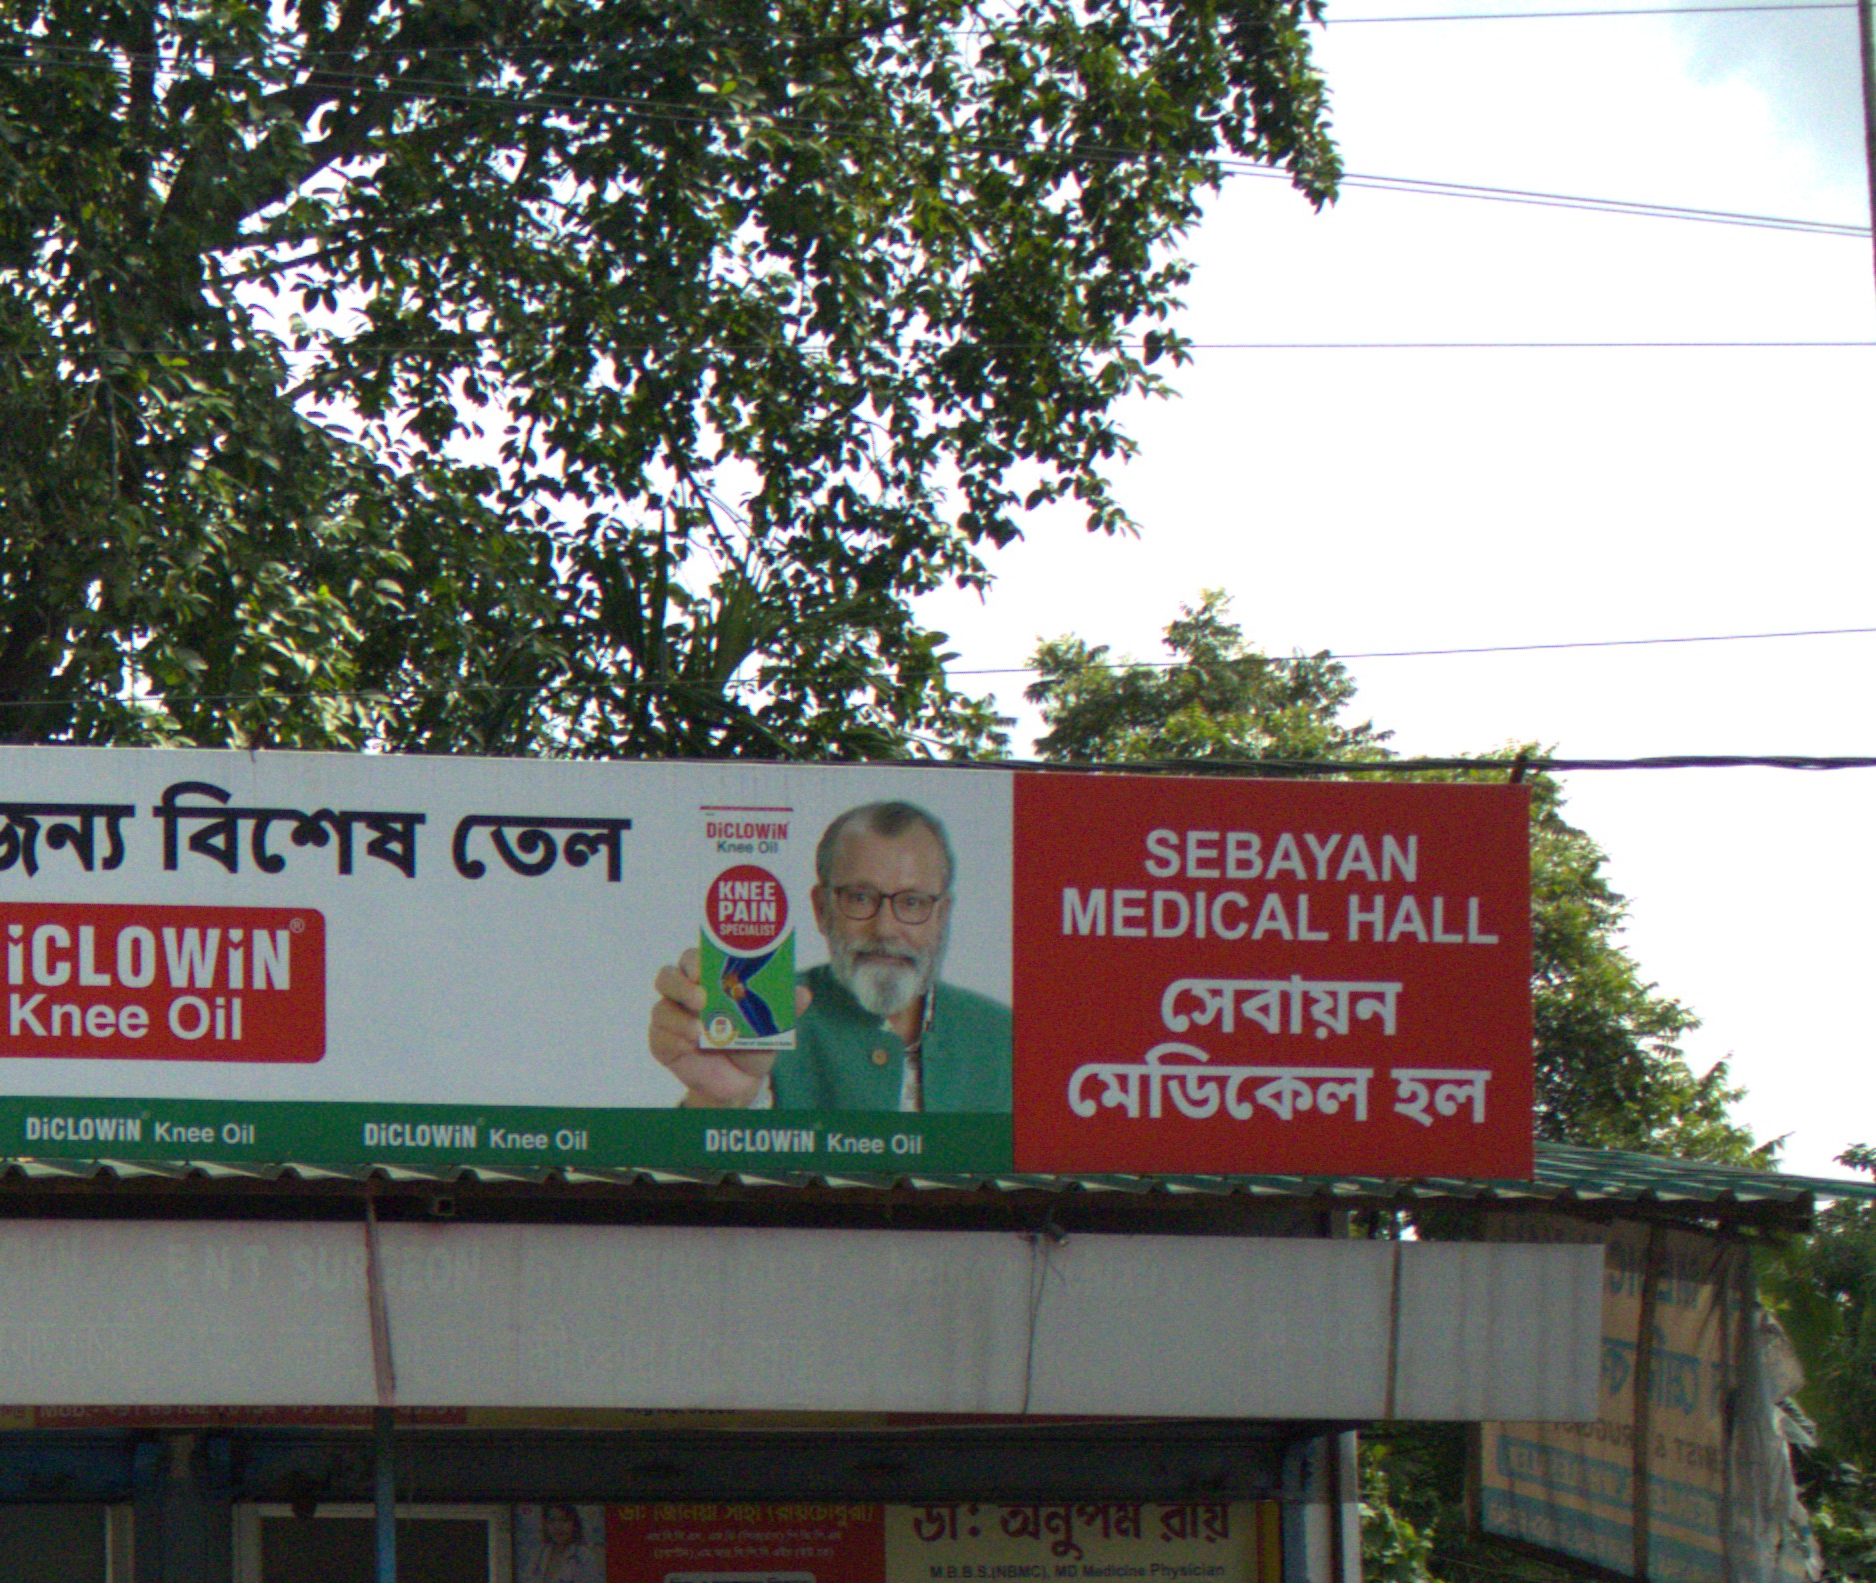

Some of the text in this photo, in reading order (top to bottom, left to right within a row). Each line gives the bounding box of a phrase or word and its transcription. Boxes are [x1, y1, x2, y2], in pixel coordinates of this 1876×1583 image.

[155, 781, 425, 878] বিশেষ
[452, 815, 631, 882] তেল
[717, 841, 778, 854] Knee Oil
[1144, 829, 1418, 883] SEBAYAN
[718, 880, 776, 900] KNEE
[718, 902, 777, 923] PAIN
[1061, 888, 1500, 945] MEDICAL HALL
[719, 924, 777, 937] SPECIALIST
[9, 993, 244, 1041] Knee Oil
[1160, 974, 1402, 1041] সেবায়ন
[1067, 1042, 1492, 1127] মেডিকেল হল
[153, 1121, 216, 1145] Knee
[222, 1121, 256, 1146] Oil
[489, 1128, 549, 1151] Knee
[555, 1128, 589, 1153] Oil
[826, 1132, 884, 1156] Knee
[890, 1132, 923, 1157] Oil
[1055, 1562, 1226, 1580] MD Medicine Physician
